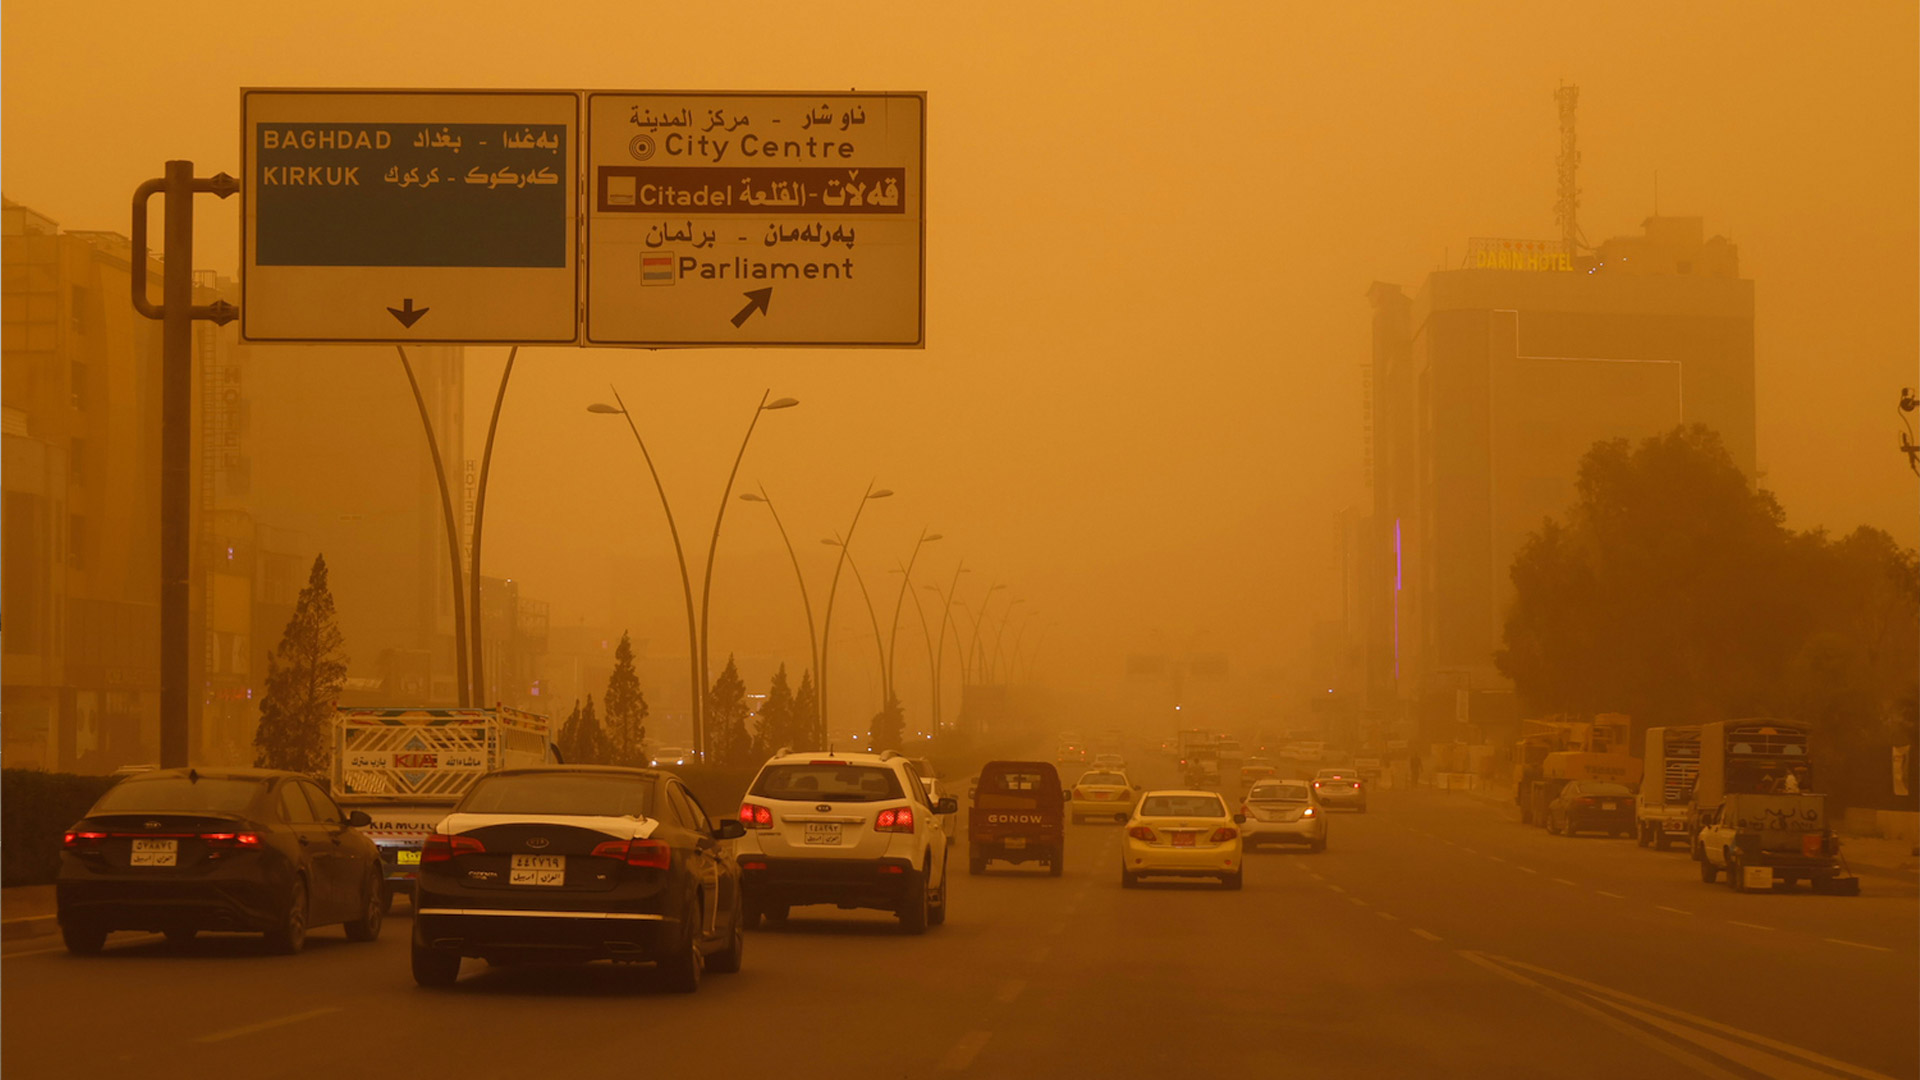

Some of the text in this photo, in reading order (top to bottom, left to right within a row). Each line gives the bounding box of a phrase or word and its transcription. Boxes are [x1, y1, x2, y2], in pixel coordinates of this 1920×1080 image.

[629, 105, 692, 132] المدينة
[701, 108, 750, 132] مركز
[801, 103, 832, 130] شار
[263, 130, 392, 149] BAGHDAD
[413, 127, 462, 153] بغداد
[665, 133, 855, 162] City Centre
[263, 166, 360, 186] KIRKUK
[639, 184, 732, 206] Citadel
[738, 177, 807, 207] القلعة
[645, 220, 716, 248] برلمان
[678, 256, 854, 280] Parliament
[1476, 250, 1574, 272] DARIN HOTEL
[393, 754, 438, 768] KIA
[370, 822, 393, 830] KIA
[988, 814, 1043, 823] GONOW
